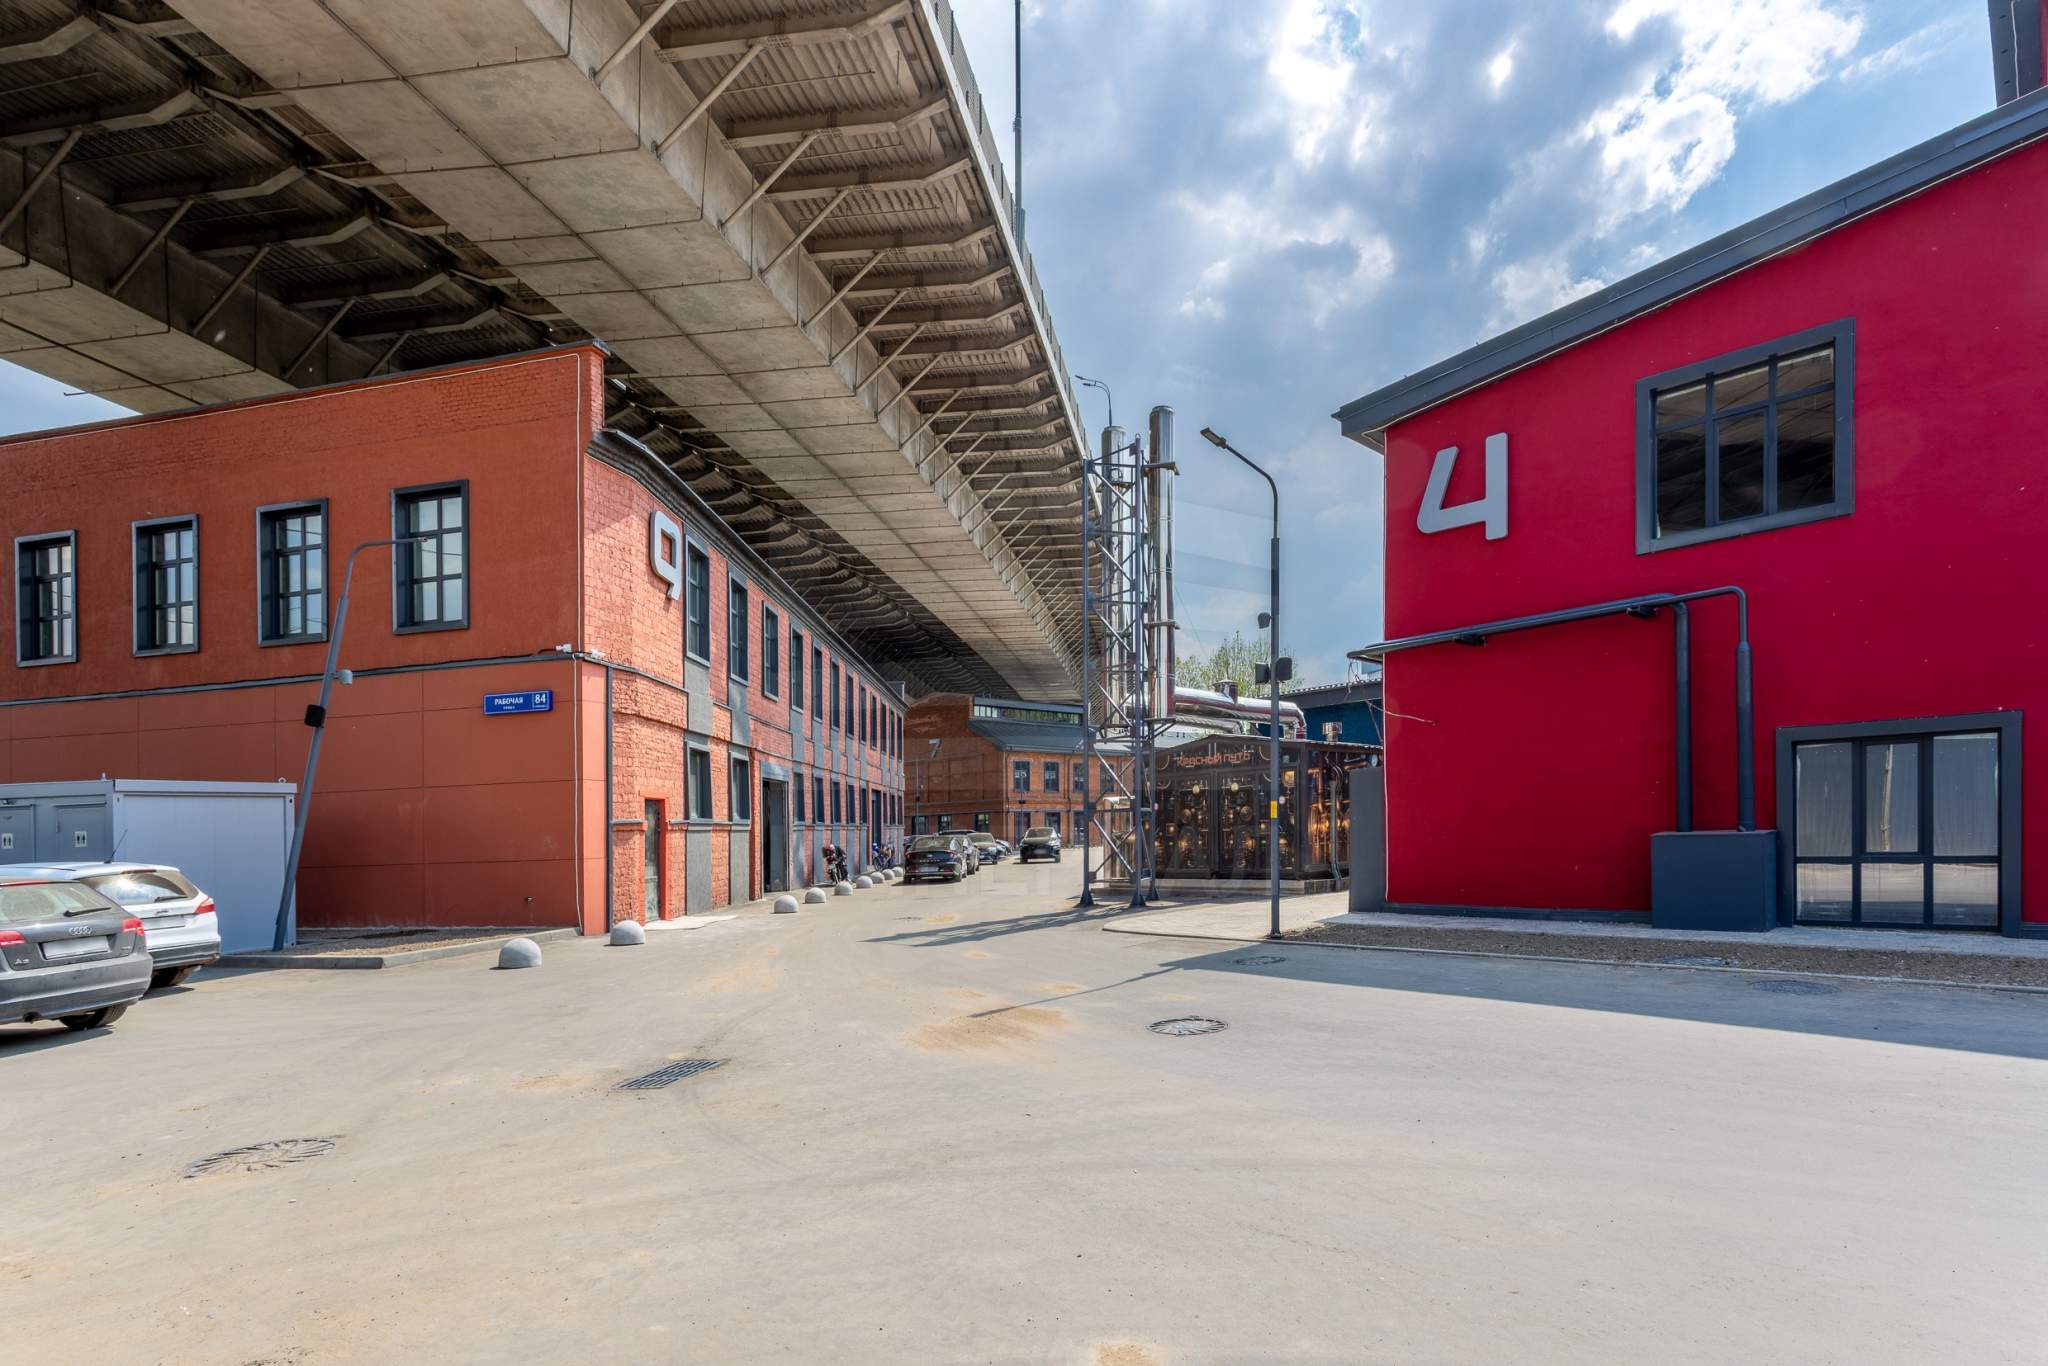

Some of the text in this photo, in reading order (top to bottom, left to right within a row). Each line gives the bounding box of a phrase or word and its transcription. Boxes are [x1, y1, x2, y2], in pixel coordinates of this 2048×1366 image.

[651, 511, 682, 601] 9
[494, 697, 524, 705] РАБОЧАЯ
[534, 693, 546, 704] 84
